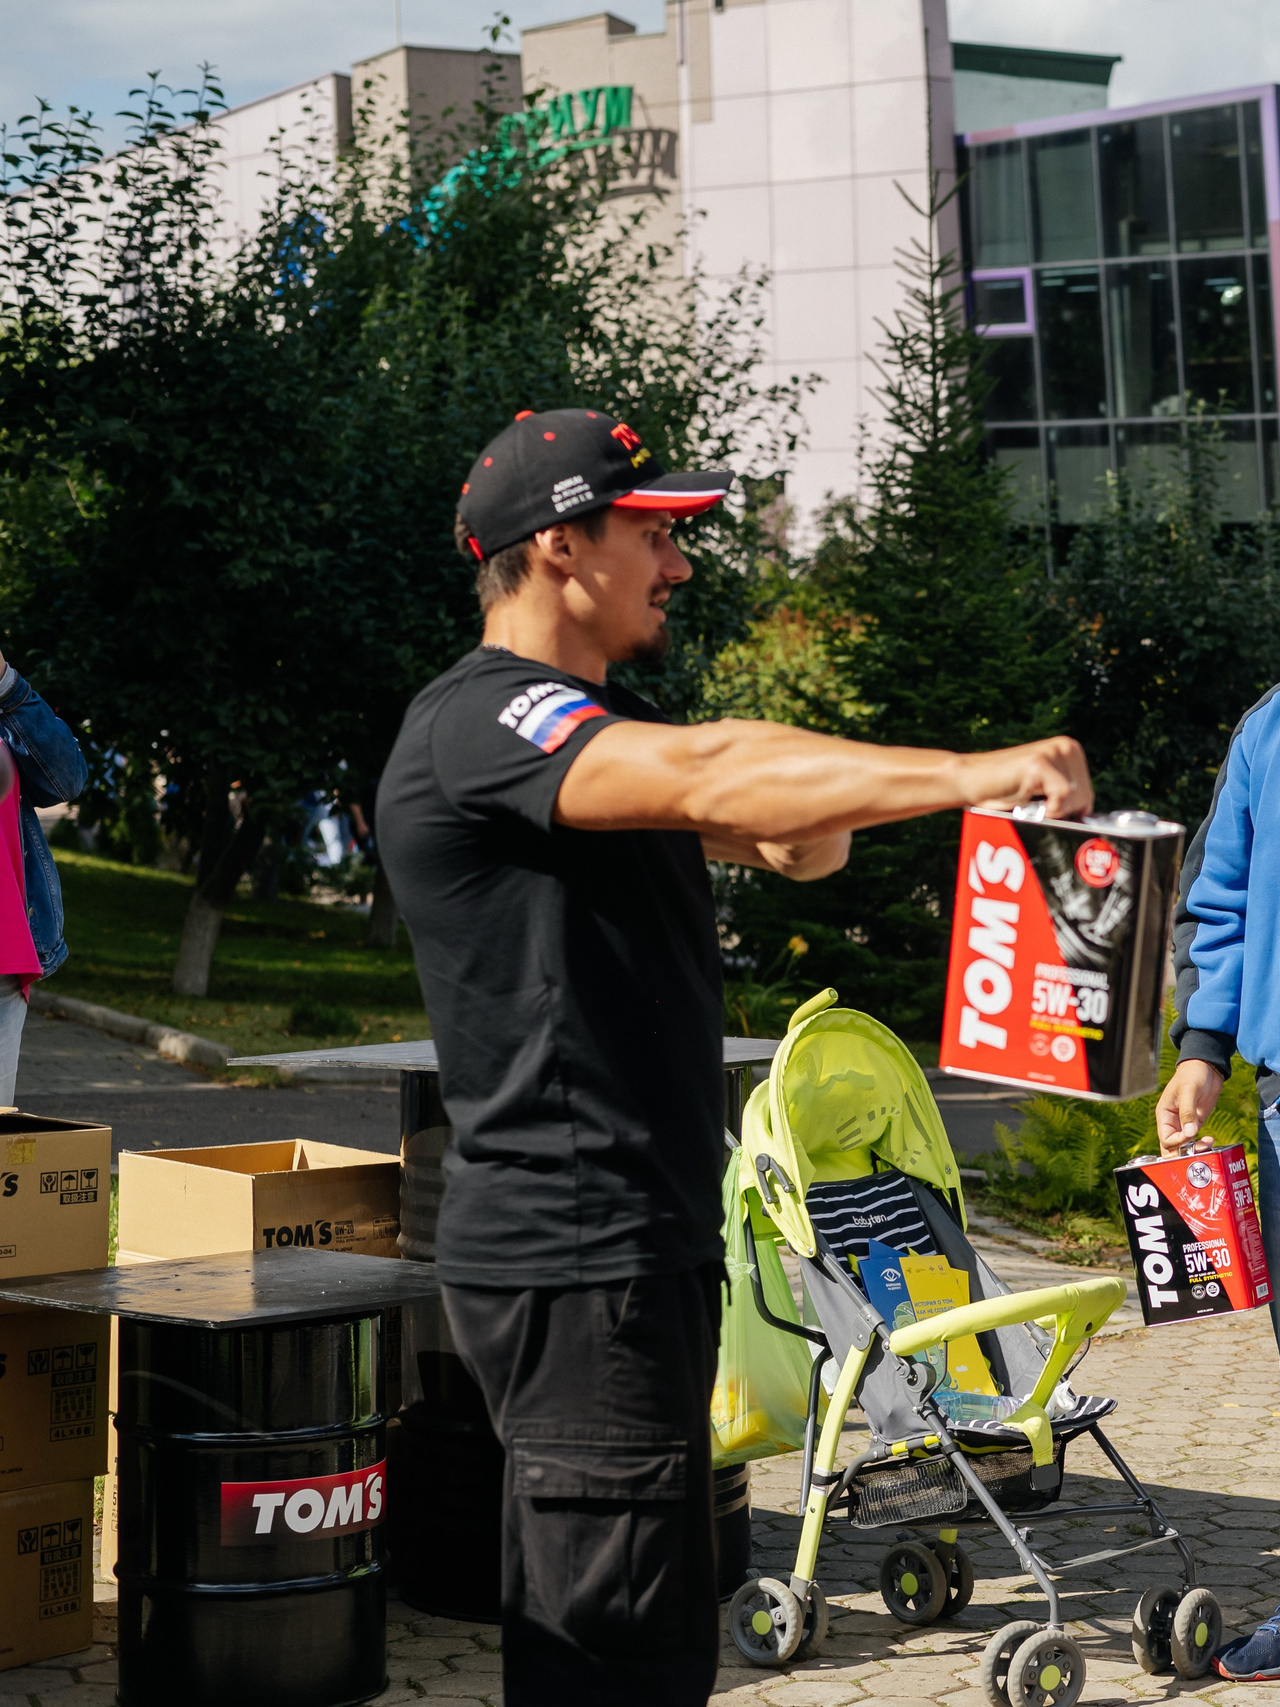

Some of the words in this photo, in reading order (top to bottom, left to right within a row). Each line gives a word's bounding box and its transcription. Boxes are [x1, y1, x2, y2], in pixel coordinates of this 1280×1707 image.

[958, 840, 1026, 1050] TOM'S
[1034, 962, 1110, 991] PROFESSIONAL
[1031, 979, 1109, 1024] 5W-30
[1228, 1158, 1246, 1174] TOM'S
[62, 1191, 96, 1204] 取扱注意
[1234, 1187, 1253, 1208] 5W-30
[262, 1219, 333, 1248] TOM'S
[334, 1224, 355, 1236] 0W-20
[1125, 1182, 1180, 1309] TOM'S
[1182, 1238, 1228, 1254] PROFESSIONAL
[1184, 1248, 1231, 1273] 5W-30
[914, 1300, 937, 1308] ИСТОРИЯ
[252, 1471, 383, 1535] TOM'S
